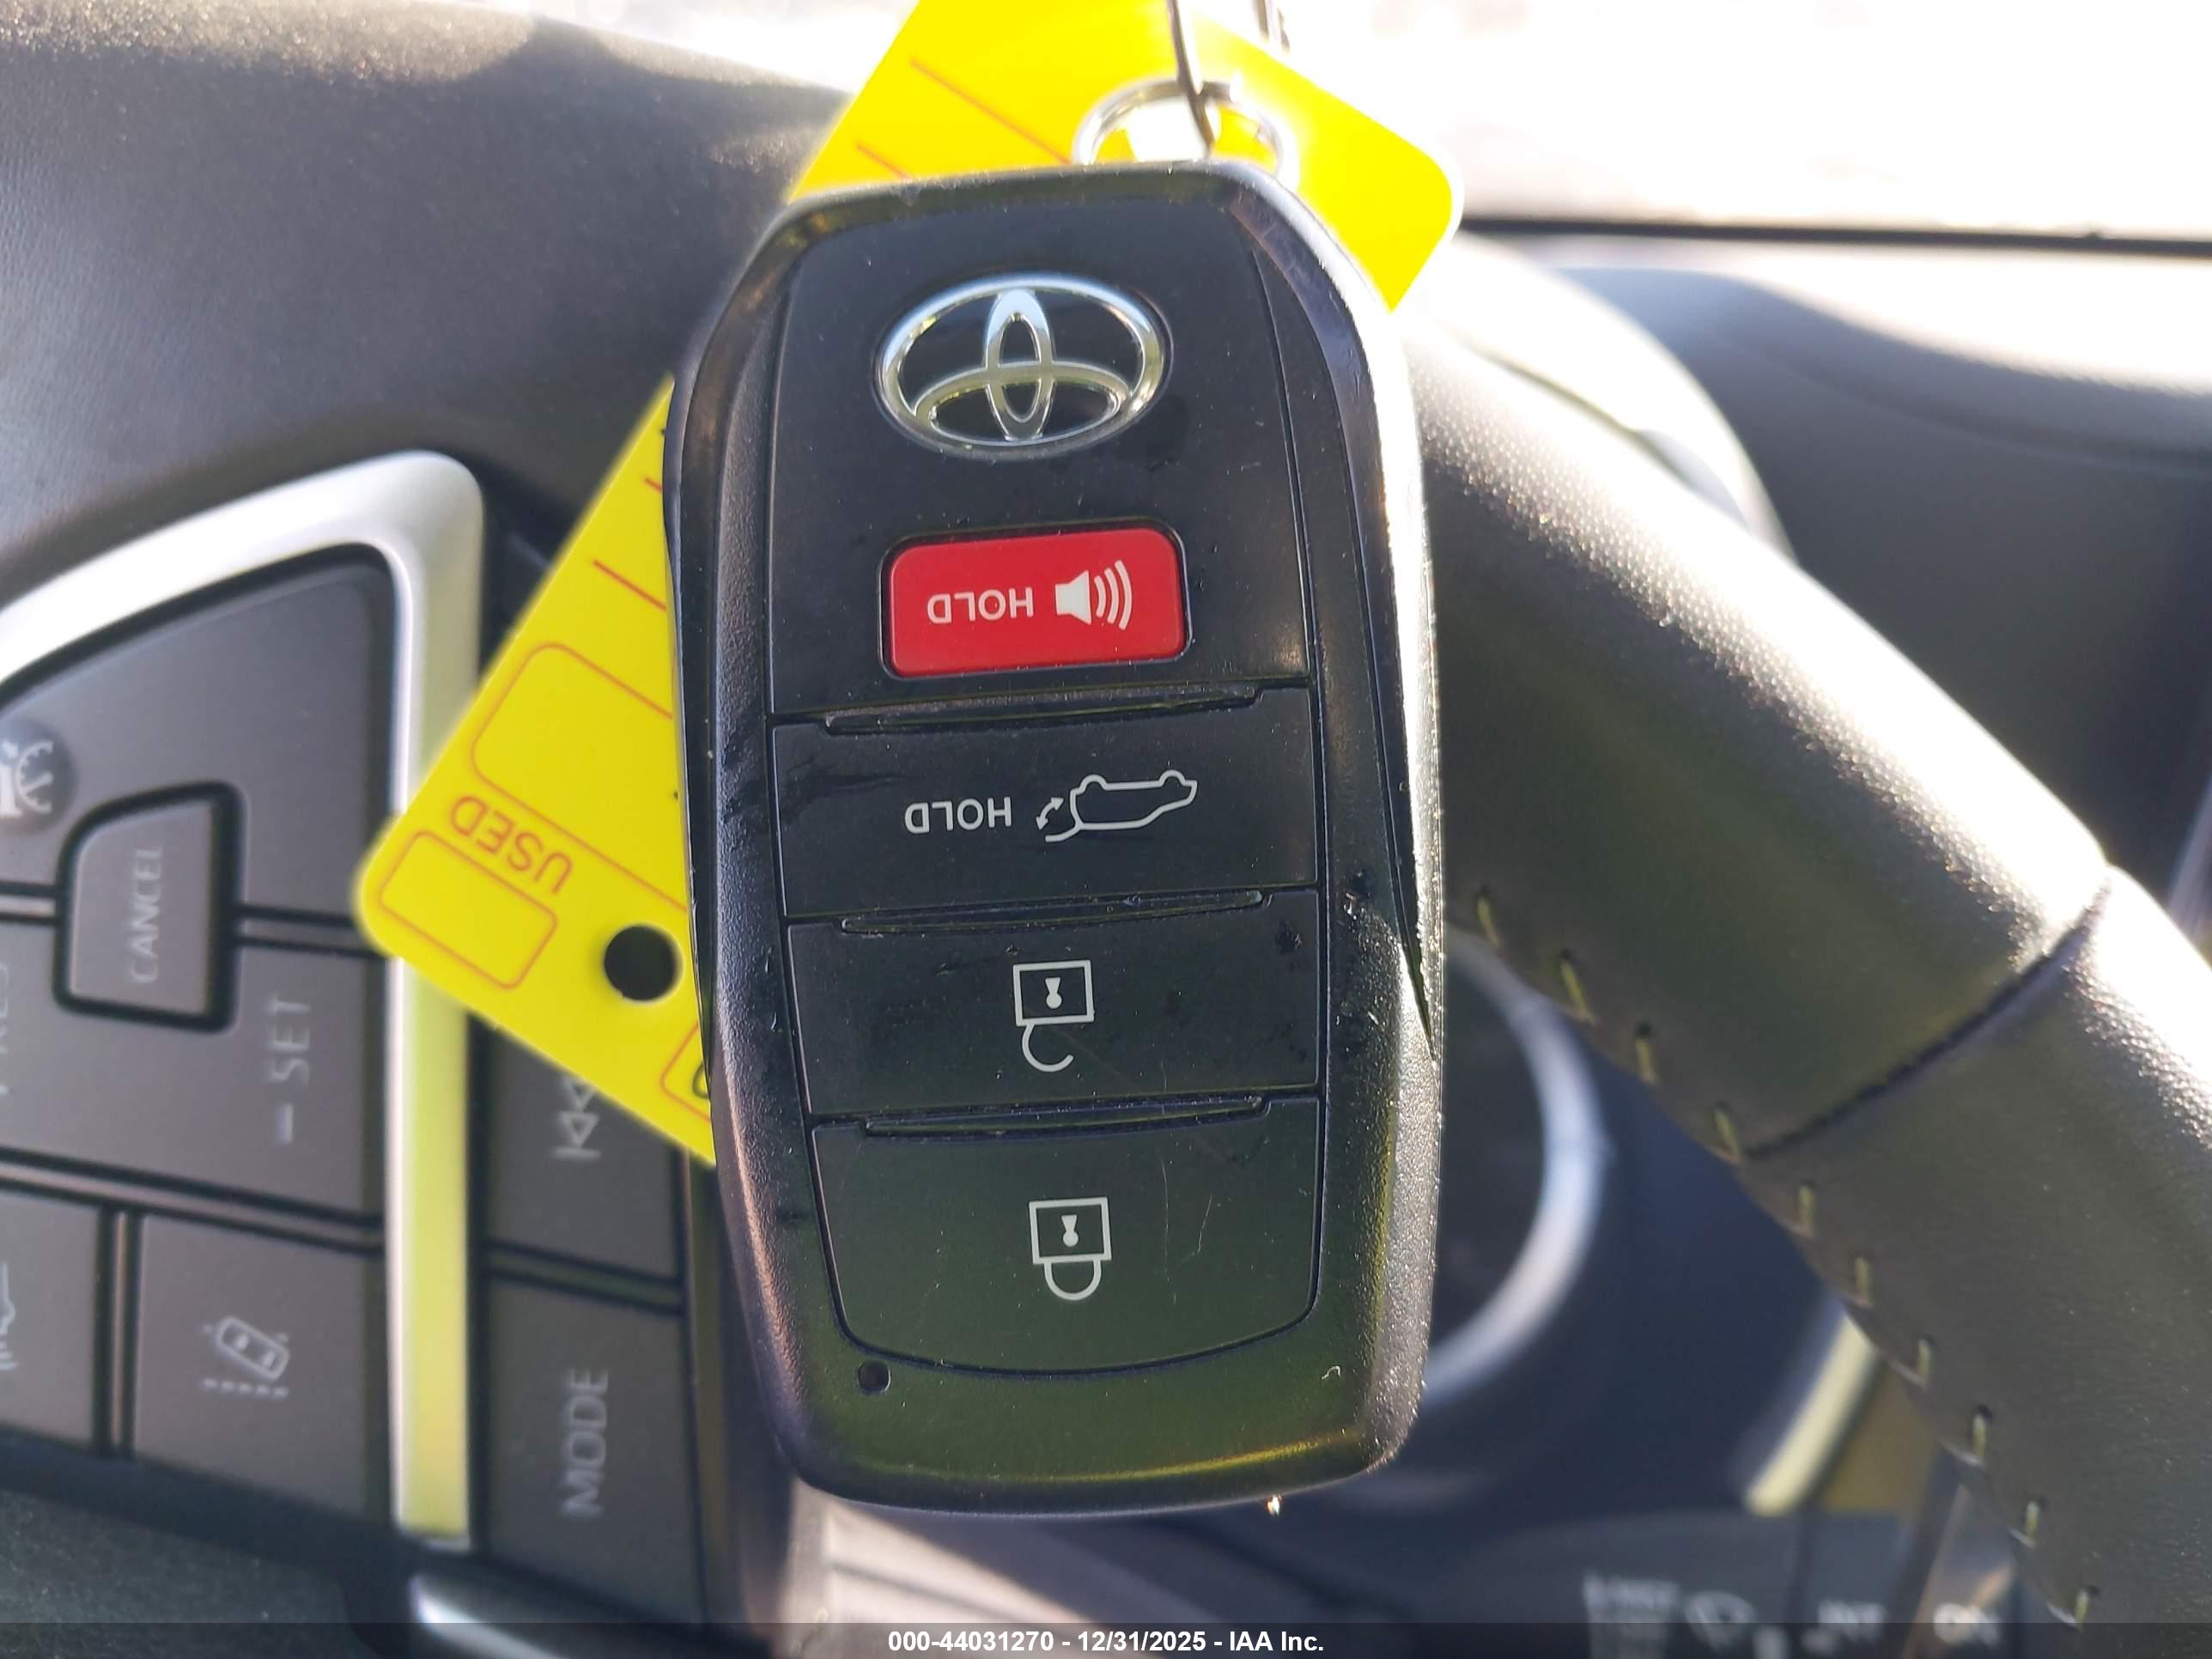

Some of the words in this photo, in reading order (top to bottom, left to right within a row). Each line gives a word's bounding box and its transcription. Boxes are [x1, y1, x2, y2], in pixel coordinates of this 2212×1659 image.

[927, 586, 1034, 624] HOLD
[450, 796, 574, 894] USED
[904, 797, 1012, 834] HOLD
[131, 844, 163, 985] CANCEL
[264, 992, 311, 1085] SET
[563, 1367, 609, 1517] MODE
